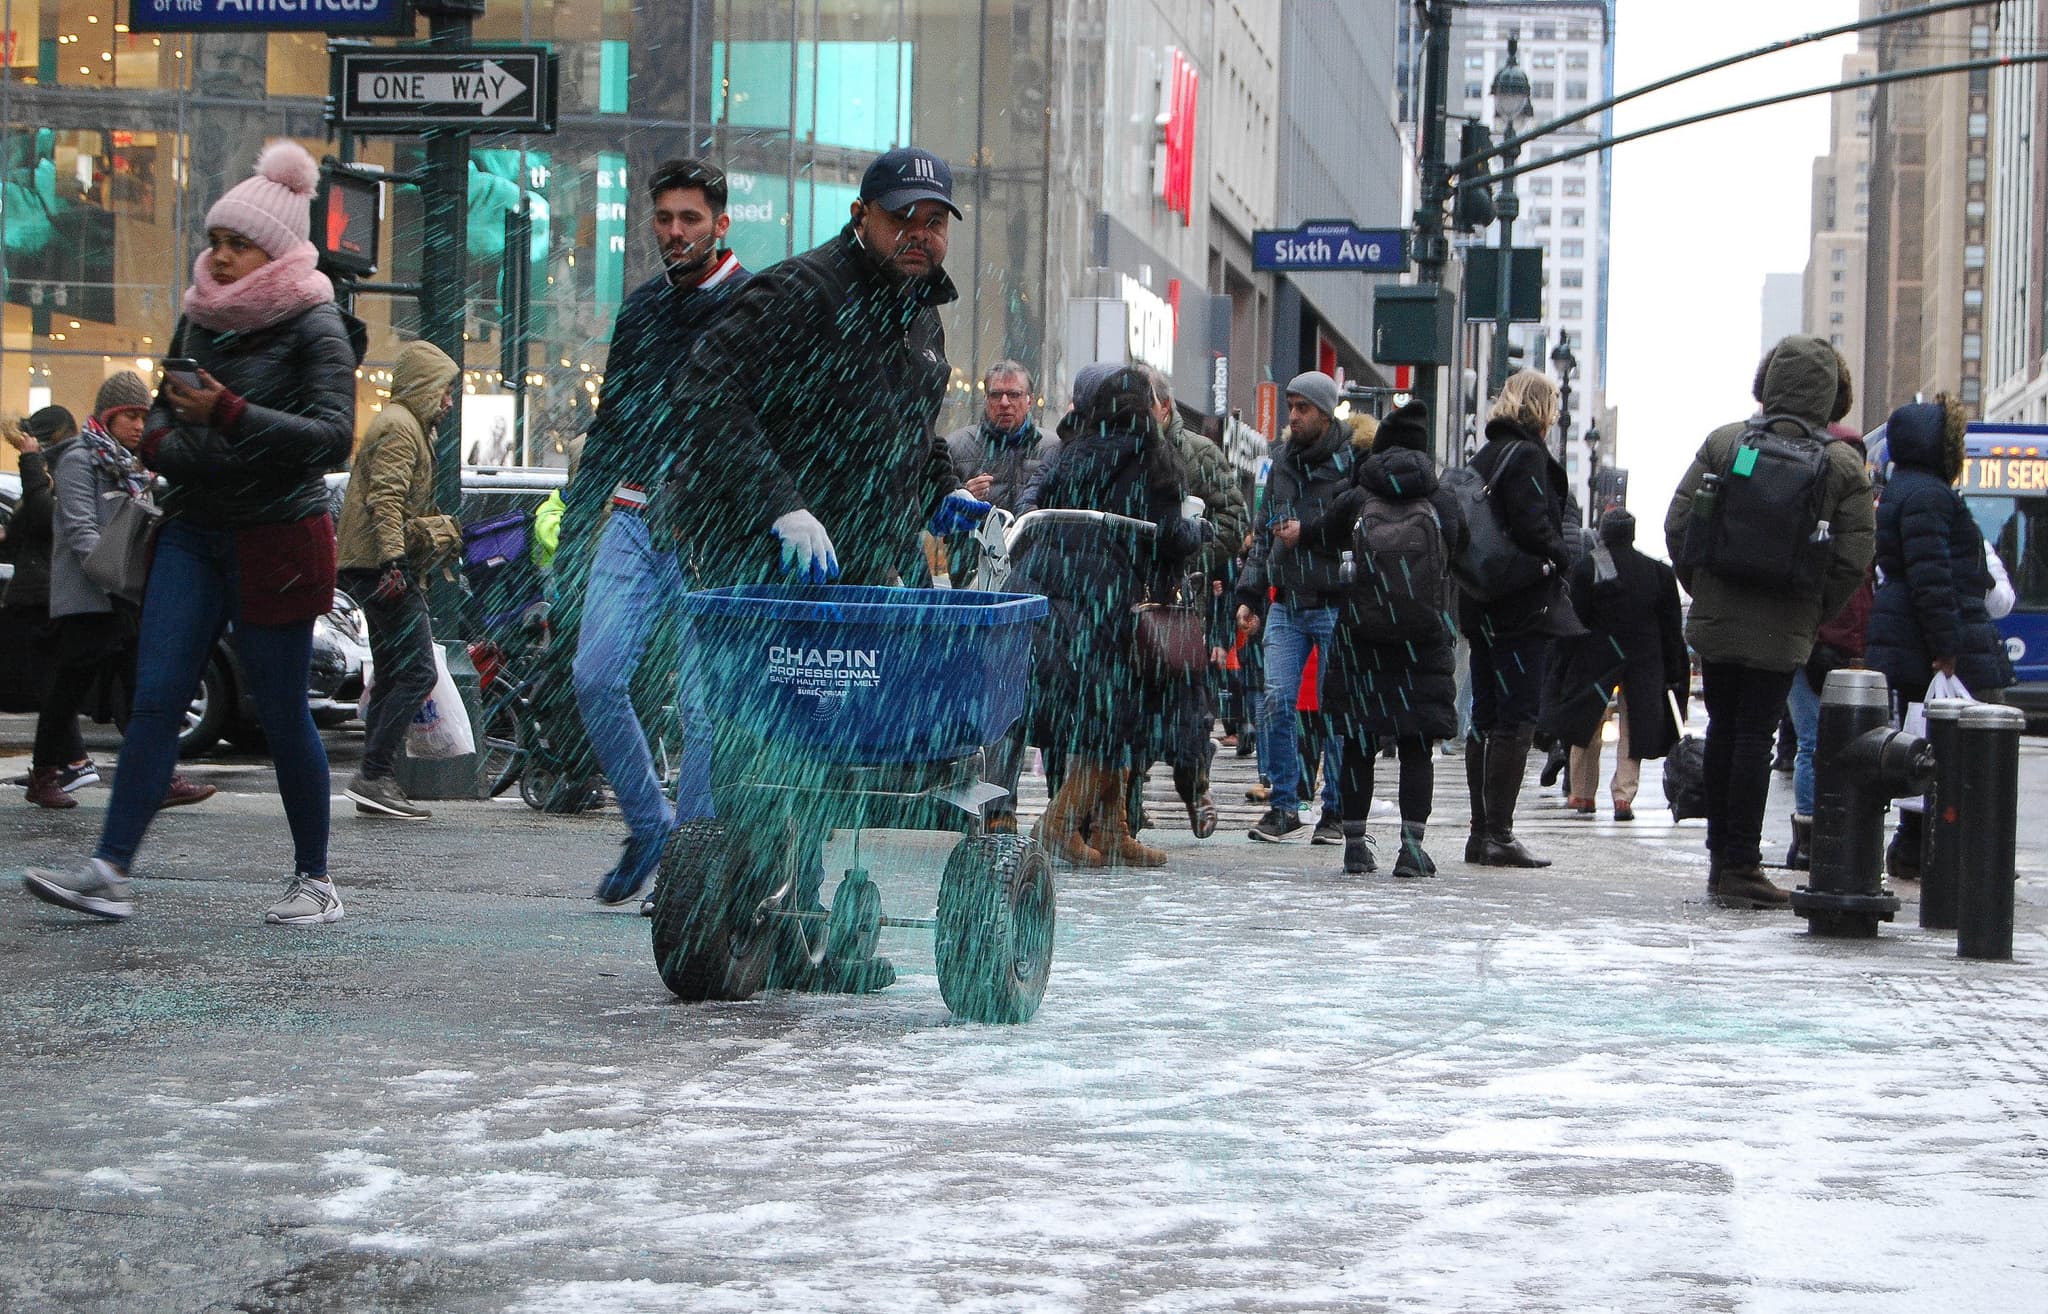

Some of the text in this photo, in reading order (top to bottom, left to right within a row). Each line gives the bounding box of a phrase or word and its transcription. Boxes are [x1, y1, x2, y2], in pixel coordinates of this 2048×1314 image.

[373, 76, 506, 100] ONE WAY
[1275, 238, 1381, 262] Sixth Ave
[1211, 356, 1228, 415] verizon
[1979, 459, 2001, 489] IN
[769, 646, 877, 668] CHAPIN
[769, 665, 880, 679] PROFESSIONAL
[769, 675, 789, 684] SALT
[796, 677, 827, 687] HALITE
[835, 679, 850, 687] ICE
